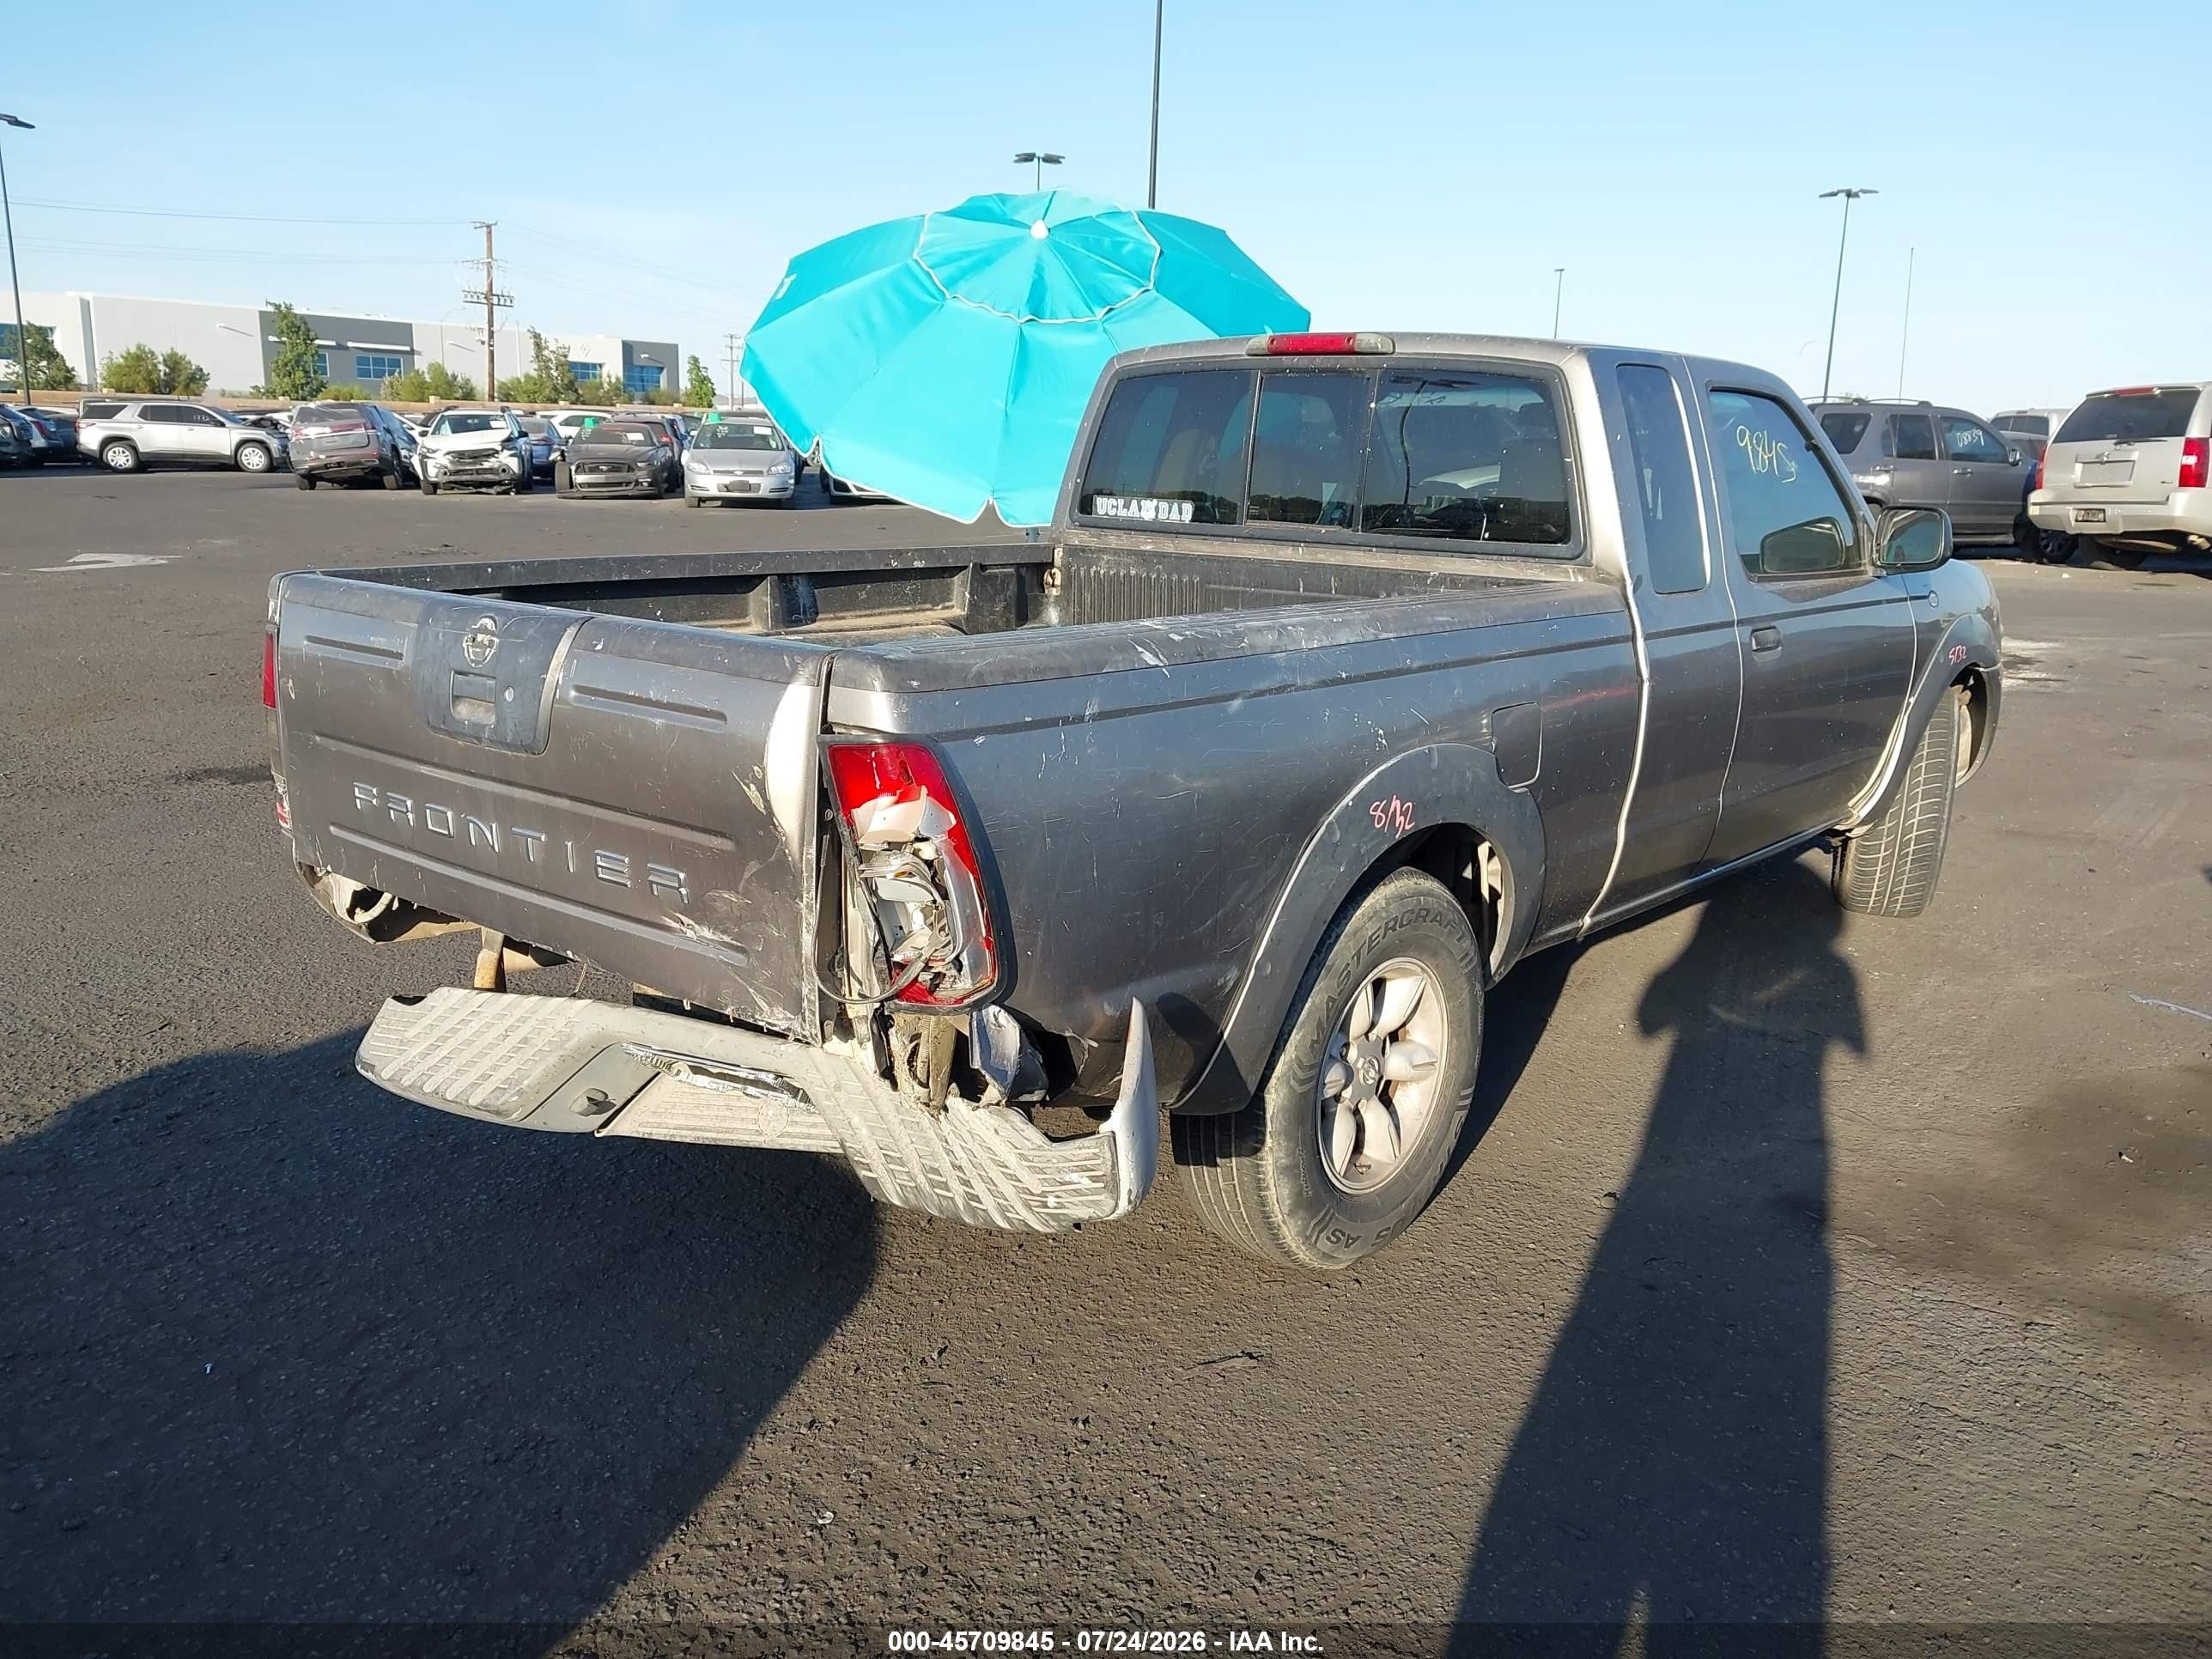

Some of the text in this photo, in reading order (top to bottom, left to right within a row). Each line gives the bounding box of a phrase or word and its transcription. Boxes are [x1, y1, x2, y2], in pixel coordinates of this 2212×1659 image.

[1097, 497, 1193, 523] UCLA DAD
[353, 781, 689, 905] FRONTIER
[1309, 907, 1474, 1059] MASTERCRAFT
[1325, 1227, 1363, 1249] AS
